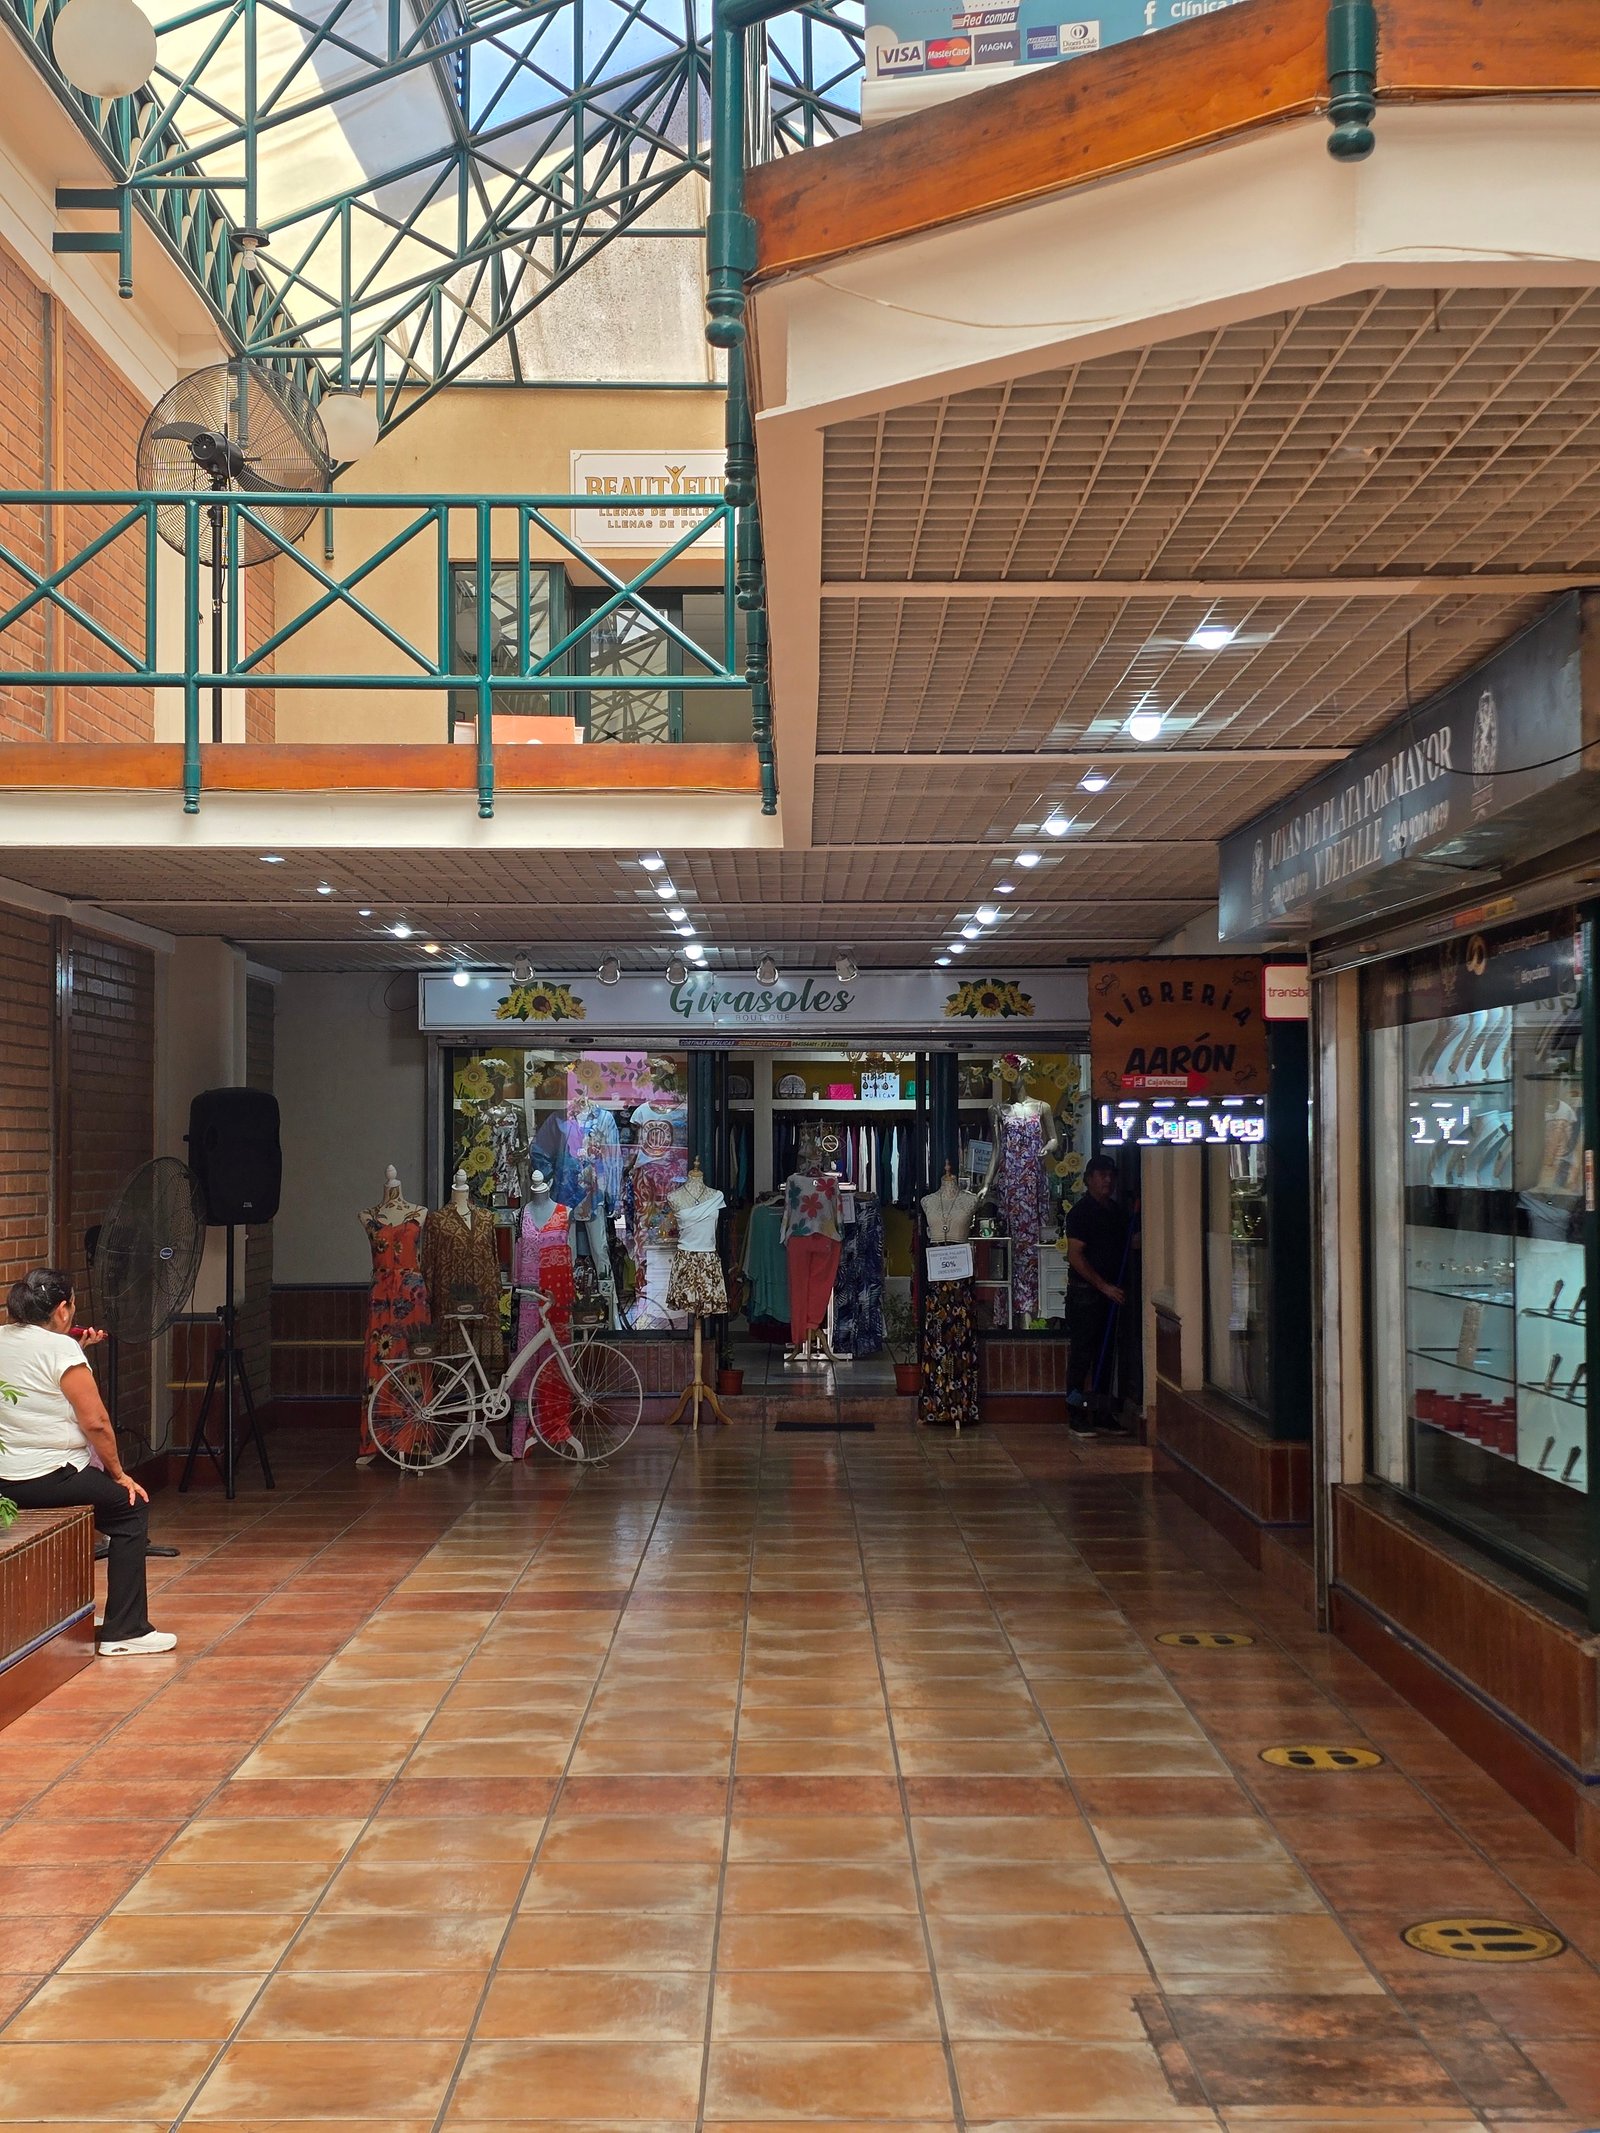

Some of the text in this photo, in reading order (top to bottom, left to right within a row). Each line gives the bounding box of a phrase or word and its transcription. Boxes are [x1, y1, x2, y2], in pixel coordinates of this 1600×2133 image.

[962, 11, 1016, 27] Red compra
[883, 46, 921, 63] VISA
[928, 46, 970, 59] MasterCard
[978, 41, 1013, 53] MAGNA
[599, 508, 714, 516] LLENAS DE BELLE
[608, 520, 653, 529] LLENAS
[659, 520, 675, 529] DE
[1269, 726, 1453, 870] JOYAS DE PLATA POR MAYOR
[1314, 818, 1382, 889] Y DETALLE
[670, 976, 855, 1018] Girasoles
[1124, 1032, 1237, 1074] AARÓN
[1147, 1078, 1187, 1088] CajaVecina
[1114, 1116, 1136, 1140] Y
[941, 1260, 956, 1268] 50%
